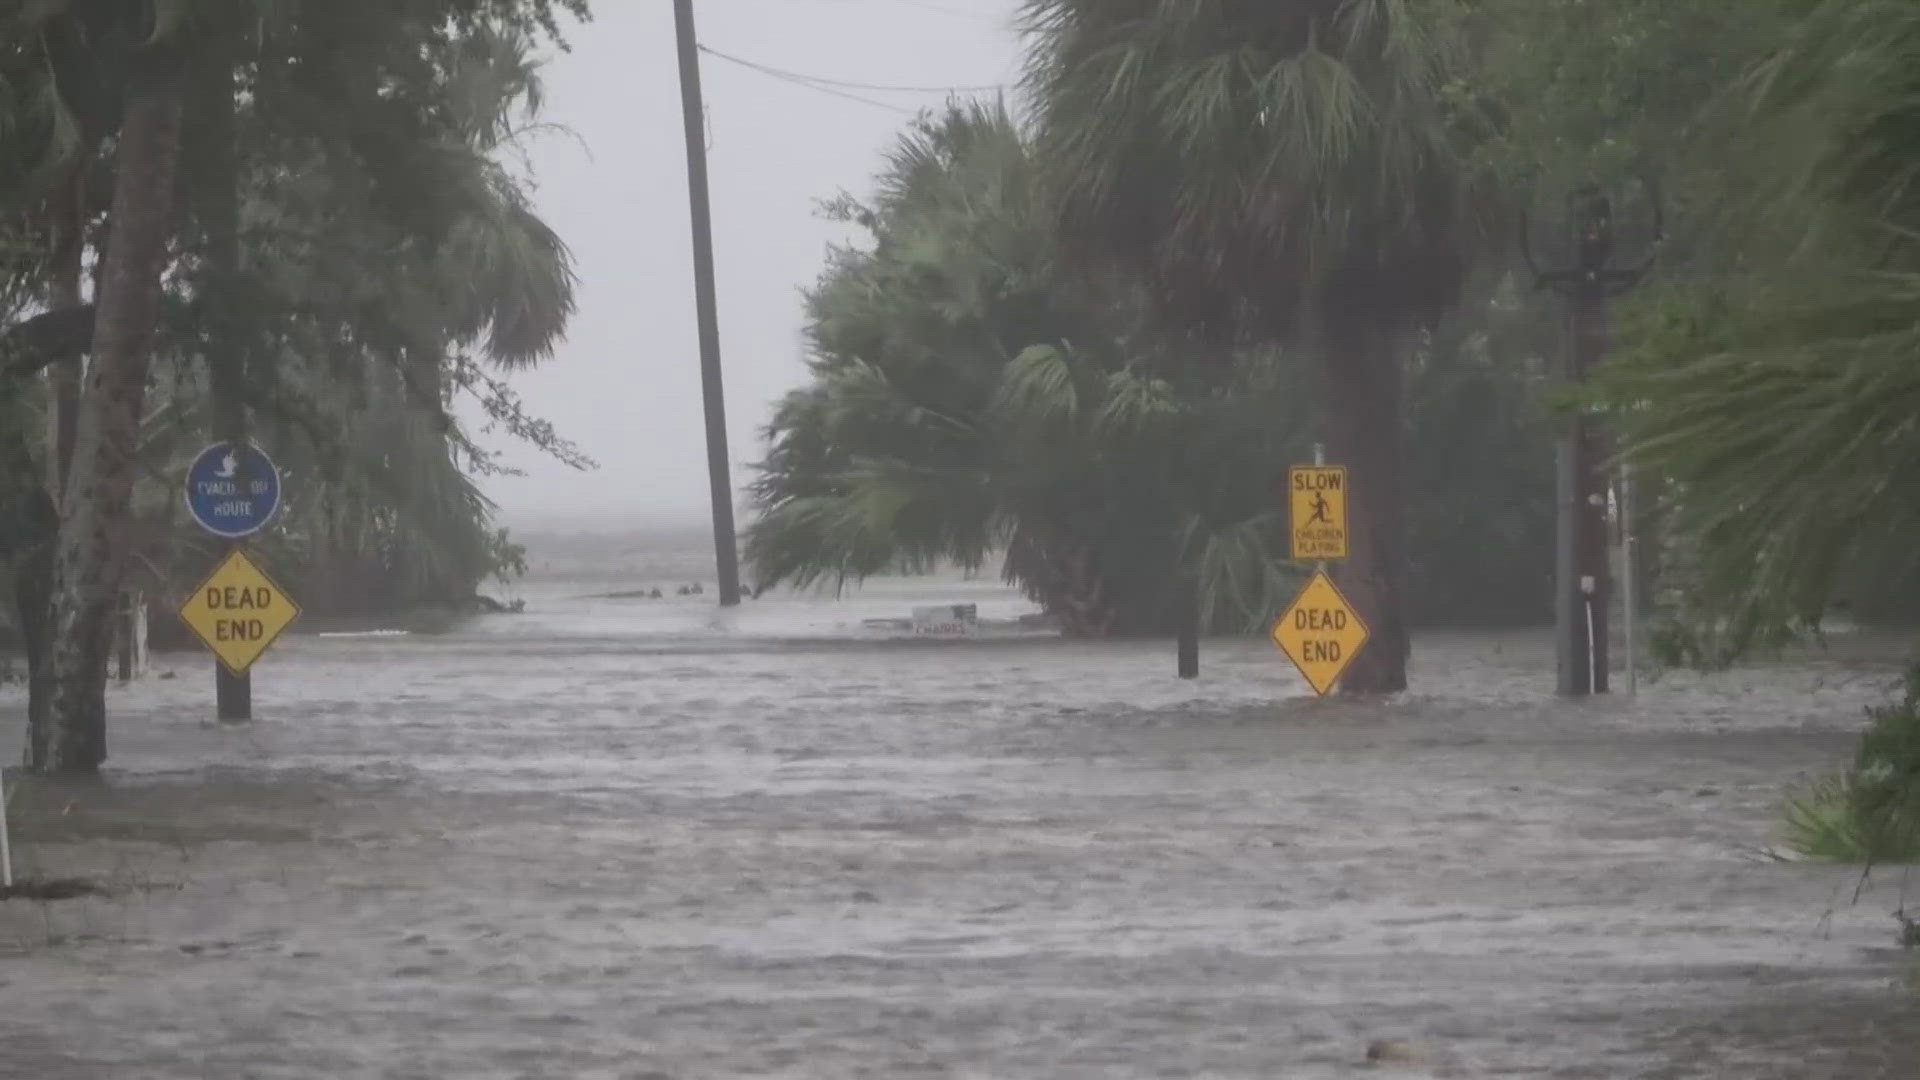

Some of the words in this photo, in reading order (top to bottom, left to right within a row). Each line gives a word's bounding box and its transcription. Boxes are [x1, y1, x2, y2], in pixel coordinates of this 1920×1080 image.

[1295, 473, 1341, 490] SLOW
[214, 501, 252, 516] ROUTE
[1295, 528, 1343, 540] CHILDREN
[207, 587, 271, 609] DEAD
[216, 619, 264, 641] END
[1295, 608, 1347, 630] DEAD
[1303, 640, 1341, 662] END
